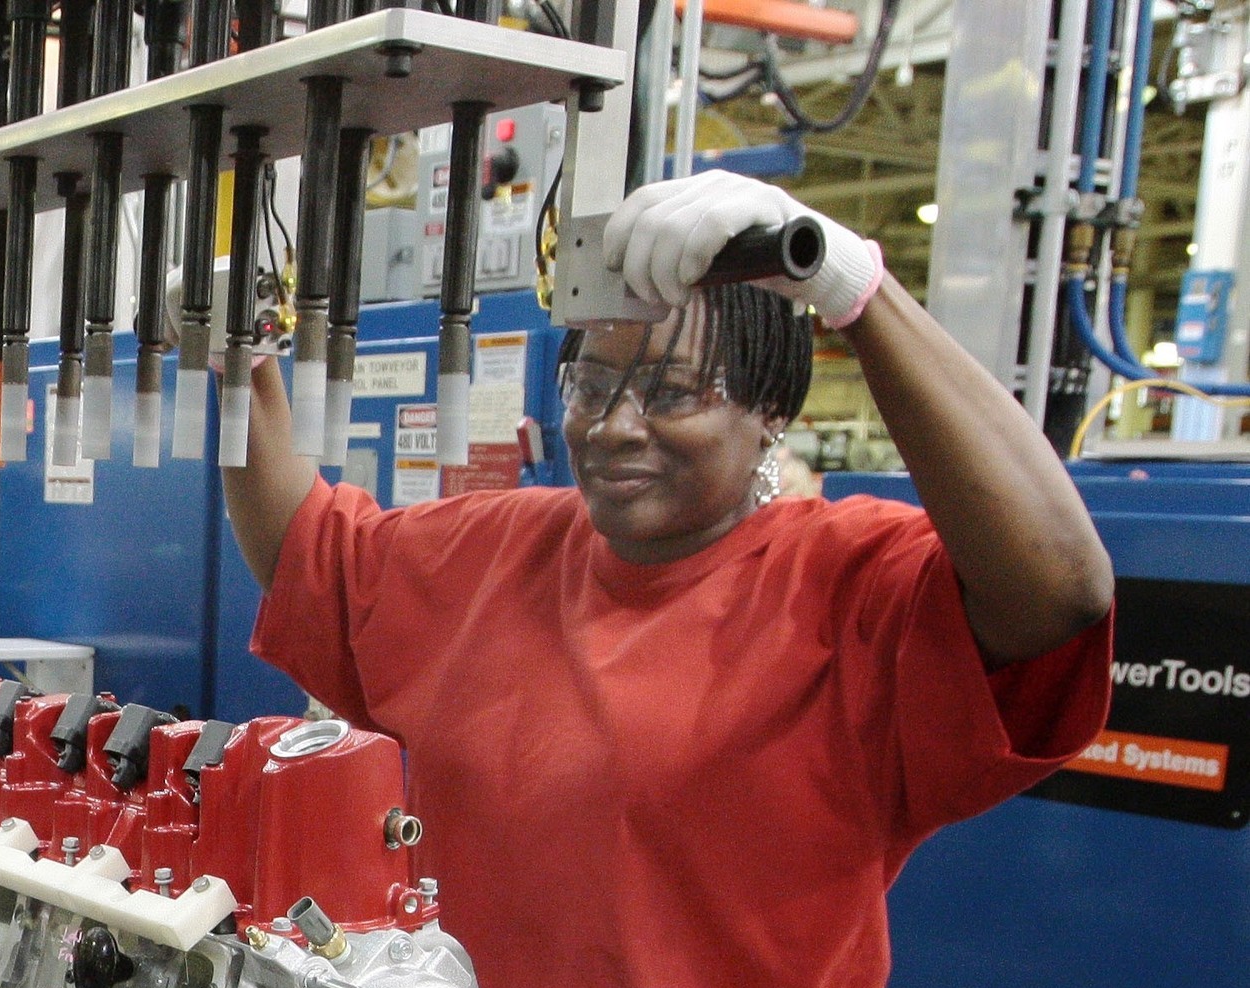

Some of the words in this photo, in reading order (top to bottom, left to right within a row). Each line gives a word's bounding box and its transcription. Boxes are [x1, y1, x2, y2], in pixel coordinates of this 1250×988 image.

[372, 376, 399, 389] PANEL
[1109, 658, 1250, 698] werTools
[1123, 743, 1220, 777] Systems
